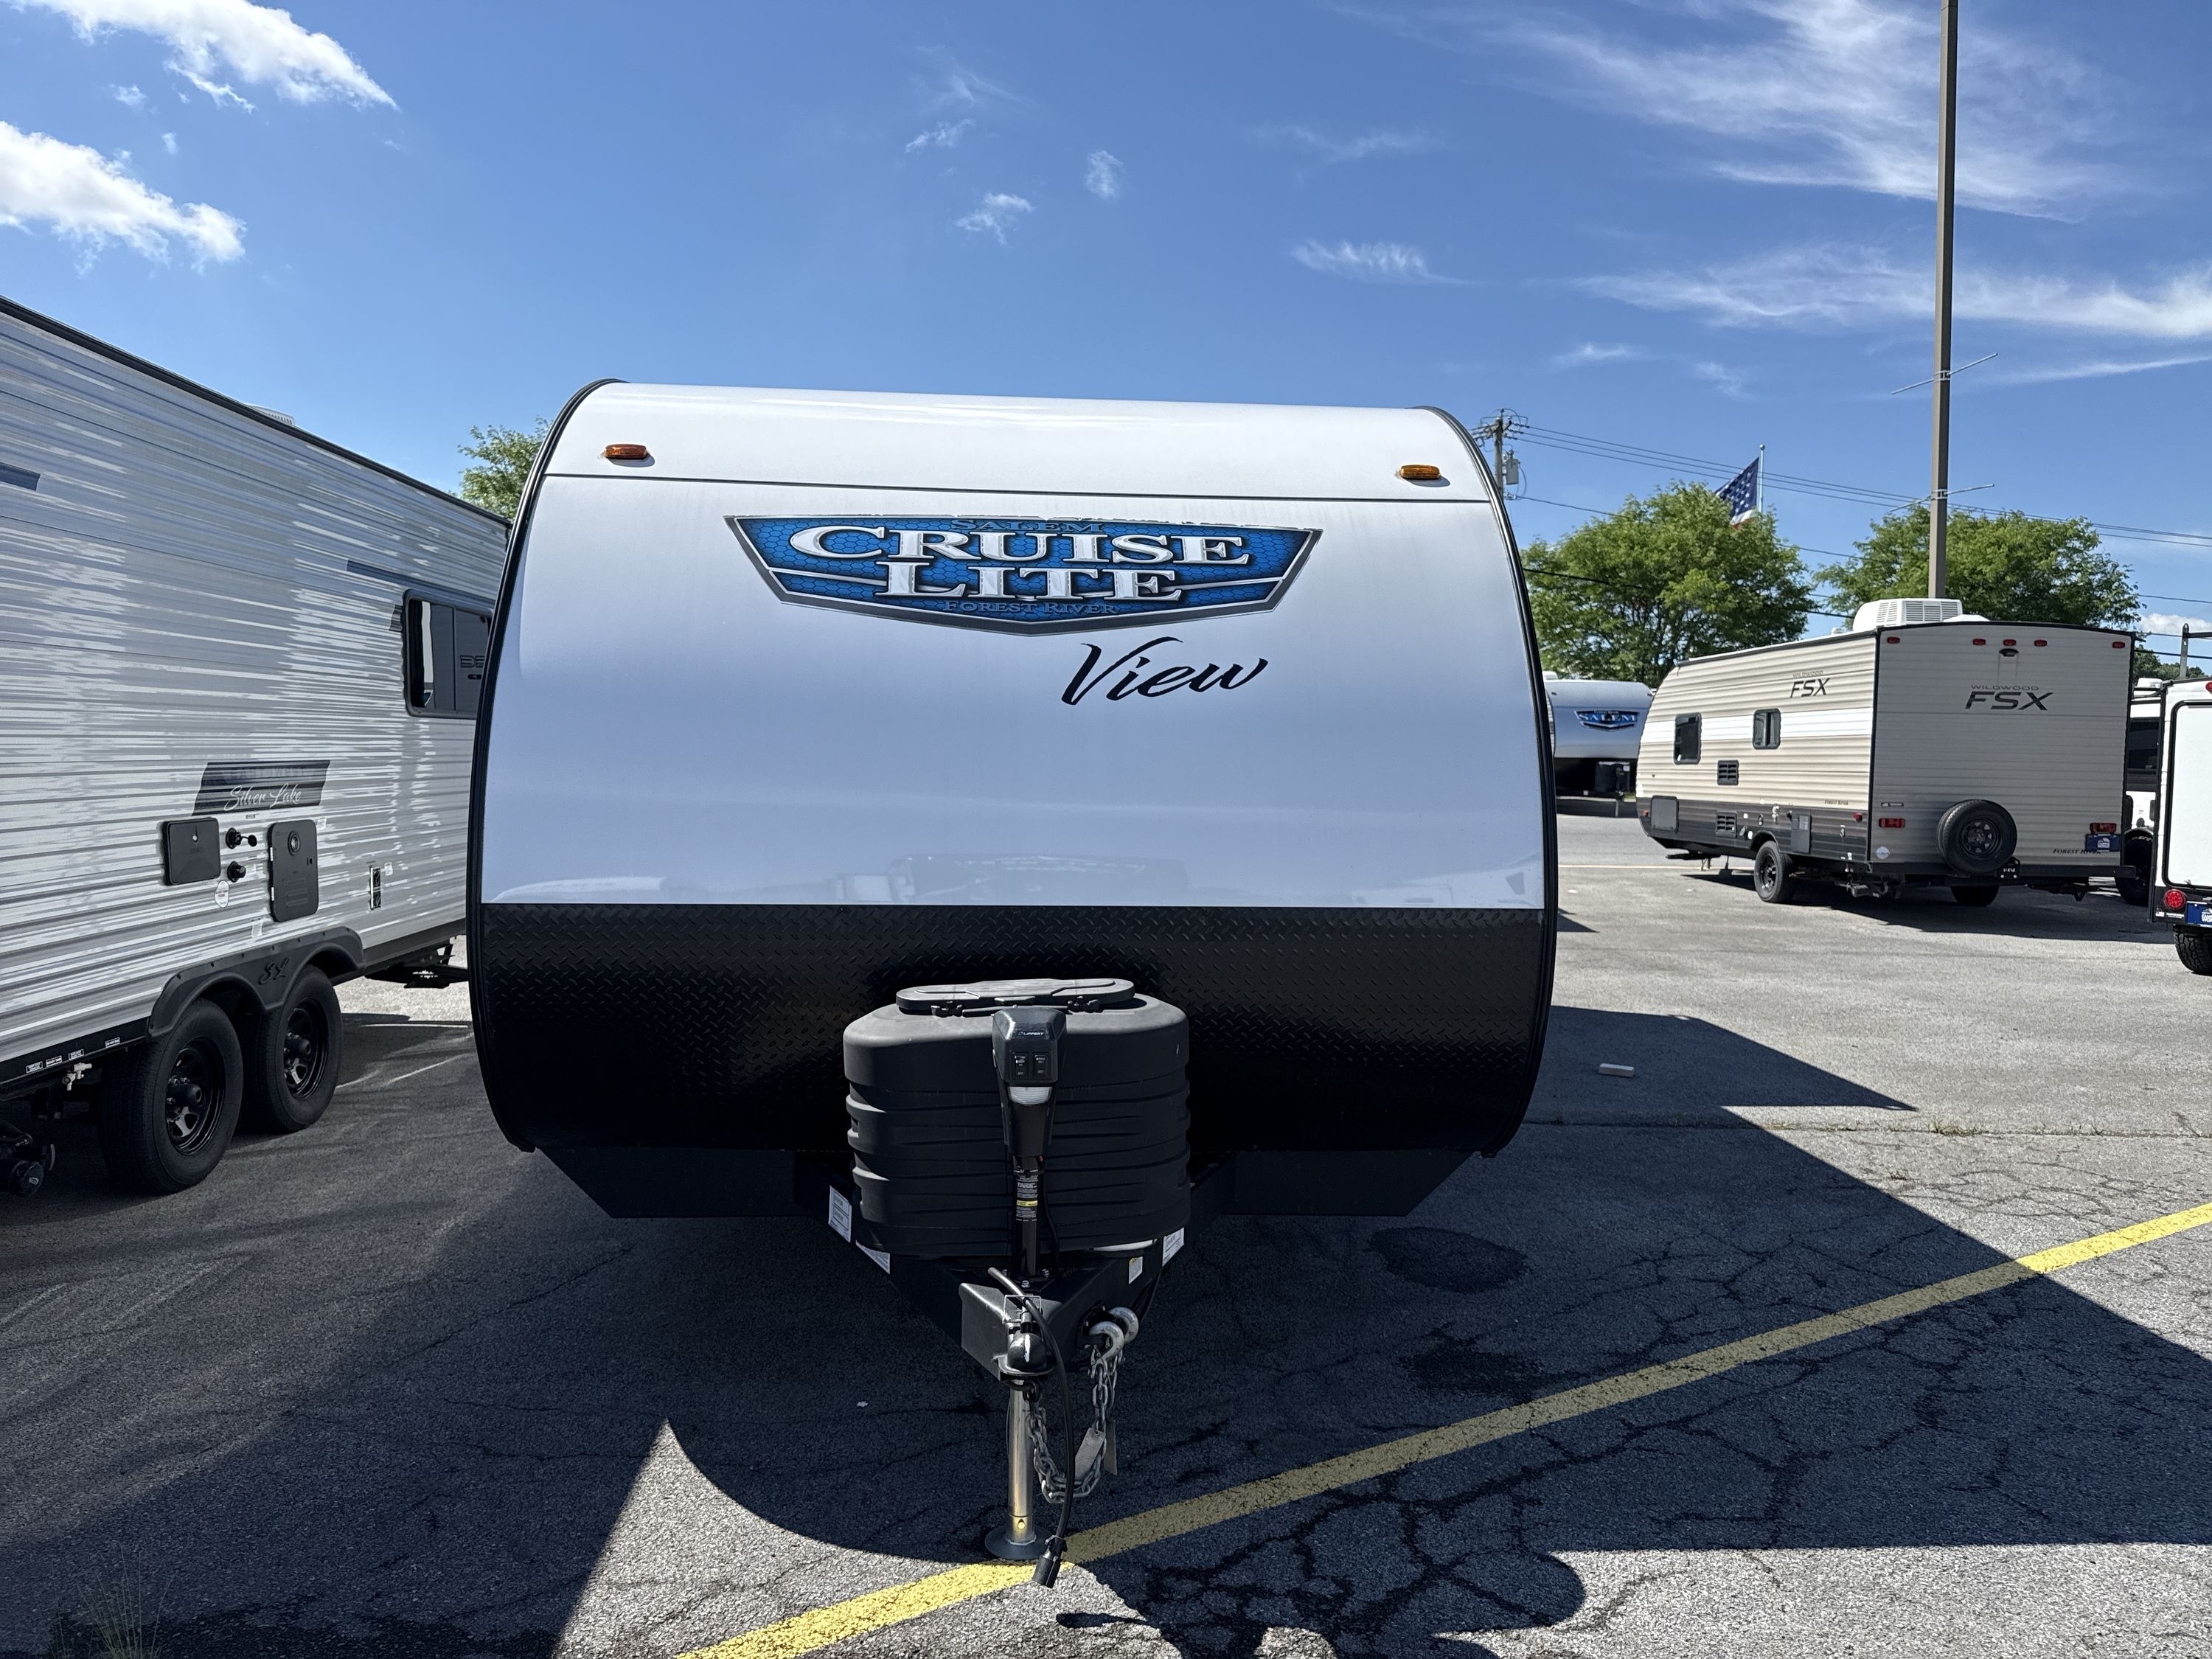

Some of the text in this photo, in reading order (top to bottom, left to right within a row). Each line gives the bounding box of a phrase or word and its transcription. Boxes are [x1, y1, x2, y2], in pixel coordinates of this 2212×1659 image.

[951, 519, 1103, 532] SALEM
[790, 525, 1249, 565] CRUISE
[874, 560, 1182, 601] LITE
[943, 600, 1117, 614] FOREST RIVER
[1061, 636, 1268, 706] View
[1790, 678, 1830, 698] FSX
[1964, 691, 2053, 711] FSX
[1579, 713, 1635, 721] SALEM
[223, 782, 302, 811] Silver Lake
